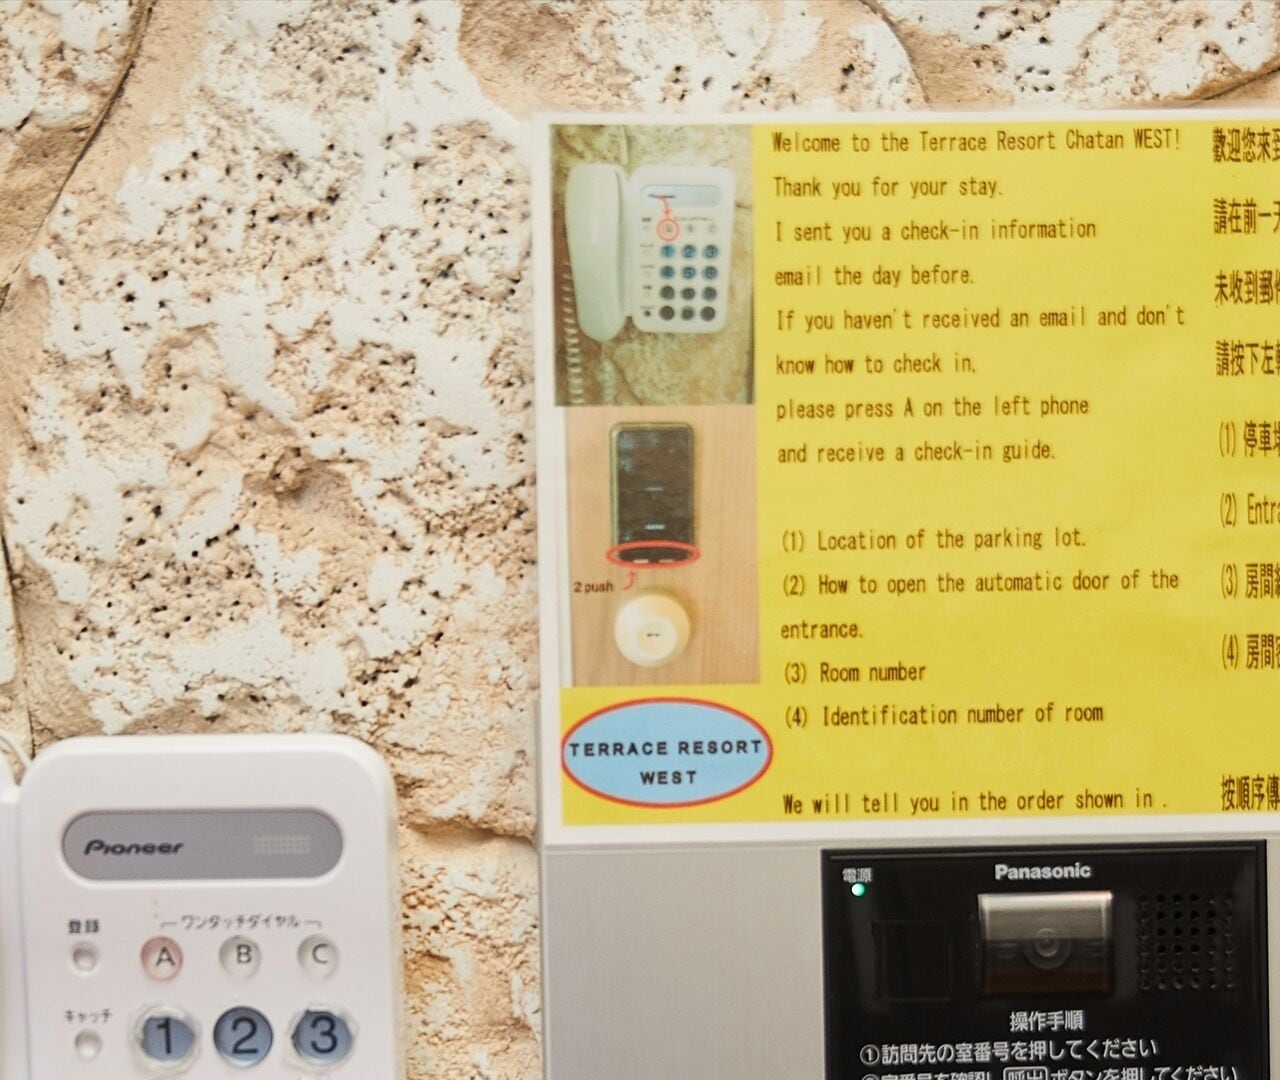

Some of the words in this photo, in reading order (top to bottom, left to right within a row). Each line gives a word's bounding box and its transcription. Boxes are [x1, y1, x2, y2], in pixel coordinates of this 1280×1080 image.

[772, 132, 840, 152] Welcome
[852, 134, 869, 152] to
[881, 132, 908, 152] the
[920, 131, 986, 151] Terrace
[998, 131, 1055, 150] Resort
[1066, 129, 1123, 149] Chatan
[1134, 128, 1179, 149] WEST!
[774, 176, 821, 196] Thank
[832, 182, 860, 200] you
[872, 176, 899, 196] for
[910, 181, 947, 199] your
[959, 177, 1001, 198] stay.
[776, 221, 783, 241] I
[794, 223, 832, 241] sent
[843, 227, 871, 244] you
[882, 226, 890, 240] a
[901, 220, 978, 240] check-in
[992, 218, 1096, 239] information
[775, 266, 820, 286] email
[834, 265, 862, 285] the
[873, 265, 901, 288] day
[912, 264, 973, 284] before.
[778, 310, 794, 330] If
[805, 316, 833, 333] you
[844, 309, 911, 329] haven't
[923, 308, 1000, 328] received
[1010, 313, 1028, 327] an
[1040, 306, 1084, 326] email
[1098, 306, 1126, 326] and
[1137, 305, 1184, 325] don't
[776, 355, 815, 374] know
[825, 354, 854, 374] how
[865, 356, 883, 373] to
[894, 353, 941, 373] check
[777, 399, 835, 421] please
[846, 403, 893, 421] press
[904, 397, 913, 416] A
[924, 402, 942, 417] on
[954, 396, 981, 416] the
[995, 395, 1030, 415] left
[1041, 395, 1088, 418] phone
[778, 443, 806, 463] and
[818, 442, 884, 462] receive
[895, 447, 904, 461] a
[915, 440, 992, 461] check-in
[1003, 440, 1054, 463] guide.
[1220, 422, 1236, 457] (1)
[1221, 493, 1236, 527] (2)
[783, 531, 804, 552] (1)
[818, 530, 896, 551] Location
[906, 529, 925, 549] of
[936, 529, 964, 548] the
[975, 528, 1042, 551] parking
[1056, 527, 1085, 546] lot.
[574, 582, 582, 593] 2
[585, 580, 614, 593] push
[784, 575, 805, 597] (2)
[819, 575, 848, 594] How
[859, 576, 877, 594] to
[887, 578, 926, 596] open
[938, 573, 964, 592] the
[976, 571, 1062, 592] automatic
[1073, 570, 1109, 590] door
[1121, 569, 1139, 589] of
[1151, 569, 1178, 589] the
[1222, 564, 1237, 598] (3)
[781, 620, 862, 639] entrance.
[1222, 634, 1239, 670] (4)
[785, 663, 806, 684] (3)
[820, 662, 860, 682] Room
[869, 661, 926, 681] number
[786, 706, 807, 728] (4)
[824, 704, 957, 726] Identification
[968, 704, 1024, 723] number
[1035, 704, 1054, 722] of
[1066, 707, 1104, 722] room
[570, 741, 667, 756] TERRACE
[678, 740, 761, 754] RESORT
[640, 771, 696, 784] WEST
[783, 794, 802, 814] We
[812, 794, 848, 813] will
[862, 793, 897, 813] tell
[910, 797, 939, 815] you
[952, 792, 968, 811] in
[979, 791, 1007, 811] the
[1017, 790, 1064, 810] order
[1076, 789, 1123, 809] shown
[1136, 788, 1152, 808] in
[84, 840, 183, 855] Pioneer
[842, 868, 872, 884] 電源
[995, 862, 1091, 880] Panasonic
[68, 920, 99, 934] 登録
[181, 915, 299, 929] ワンタッチダイヤル
[155, 946, 177, 967] A
[236, 943, 253, 965] B
[311, 943, 330, 965] C
[65, 1009, 111, 1022] キャッチ
[1010, 1010, 1083, 1032] 操作手順
[156, 1020, 175, 1055] 1
[230, 1016, 260, 1054] 2
[309, 1016, 339, 1053] 3
